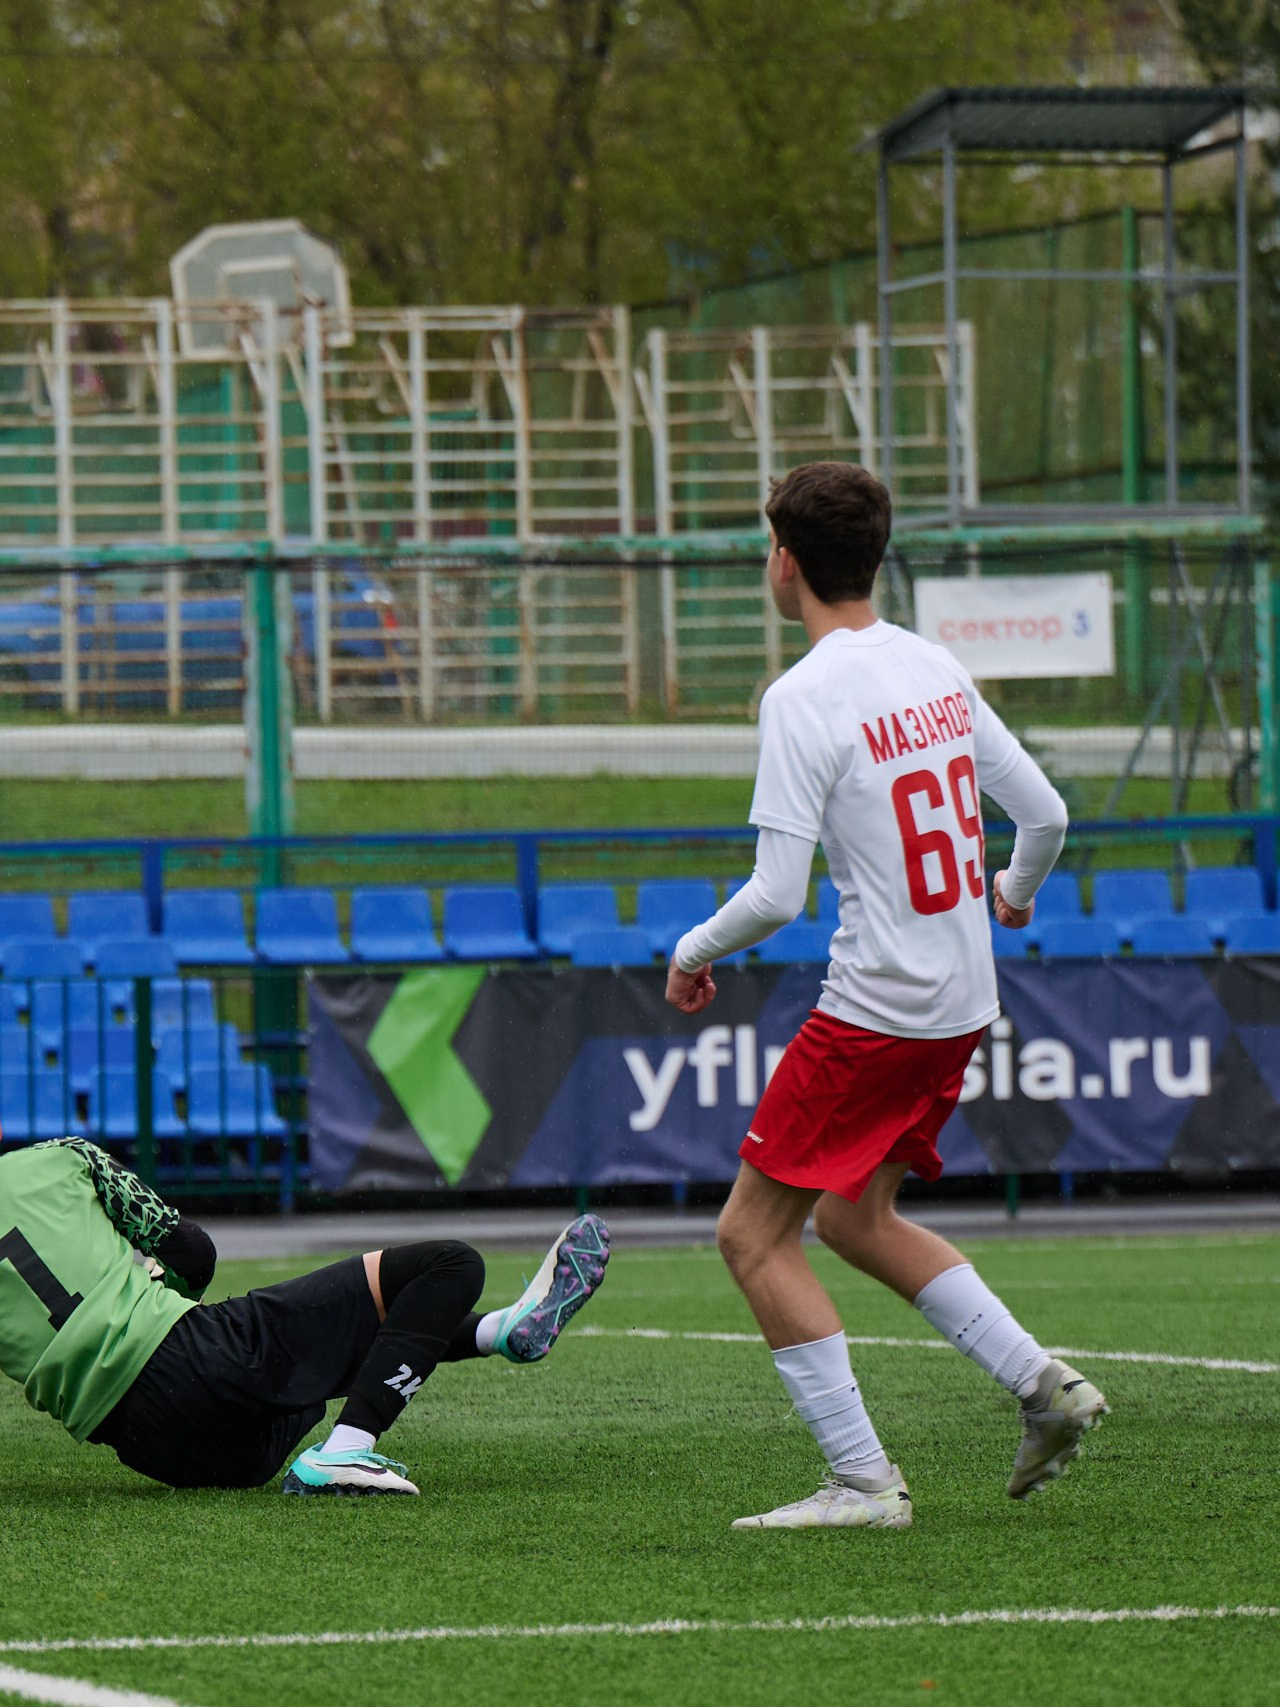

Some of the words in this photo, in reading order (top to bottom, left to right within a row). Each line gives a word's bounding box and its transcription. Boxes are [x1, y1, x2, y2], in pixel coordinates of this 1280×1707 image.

[938, 616, 1063, 645] сектор
[1072, 609, 1091, 637] 3
[891, 754, 984, 916] 69
[622, 1016, 1212, 1131] yflsia.ru
